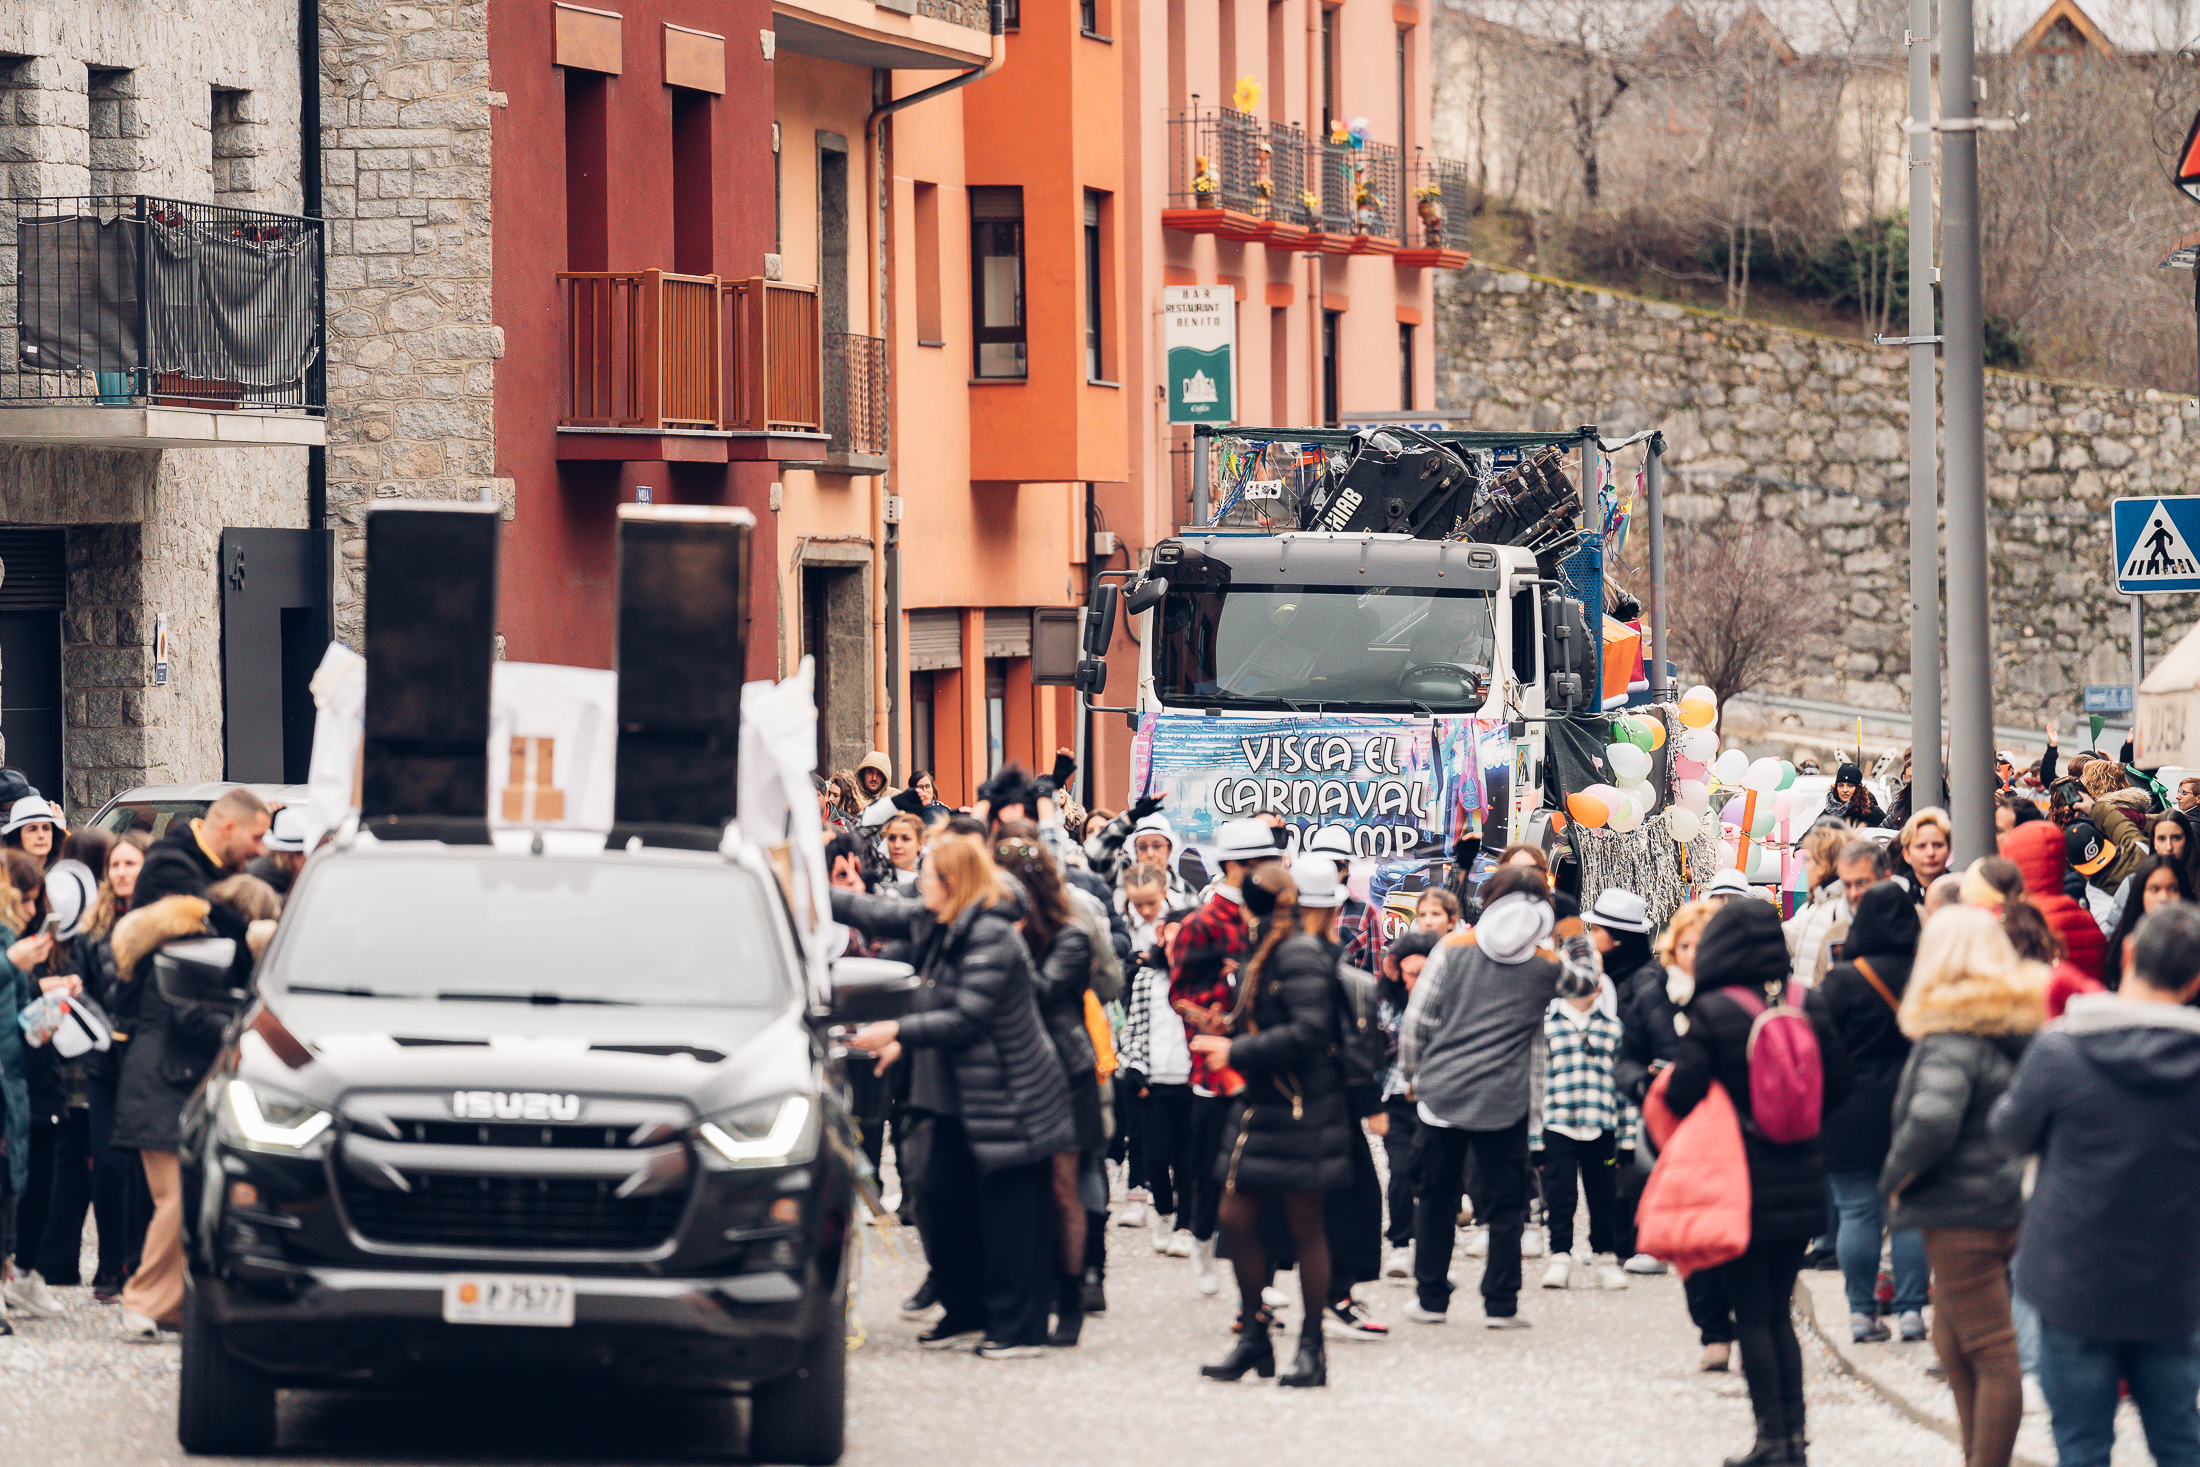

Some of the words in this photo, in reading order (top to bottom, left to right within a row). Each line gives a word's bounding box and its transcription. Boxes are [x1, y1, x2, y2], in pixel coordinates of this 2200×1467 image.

[1166, 303, 1219, 313] RESTAURANT
[1183, 289, 1210, 299] BAR
[1177, 317, 1220, 326] BENITO
[1324, 487, 1363, 532] HIAB
[1240, 735, 1353, 774] VISCA
[1363, 736, 1400, 775] EL
[1213, 778, 1427, 820] CARNAVAL
[453, 1090, 581, 1121] ISUZU
